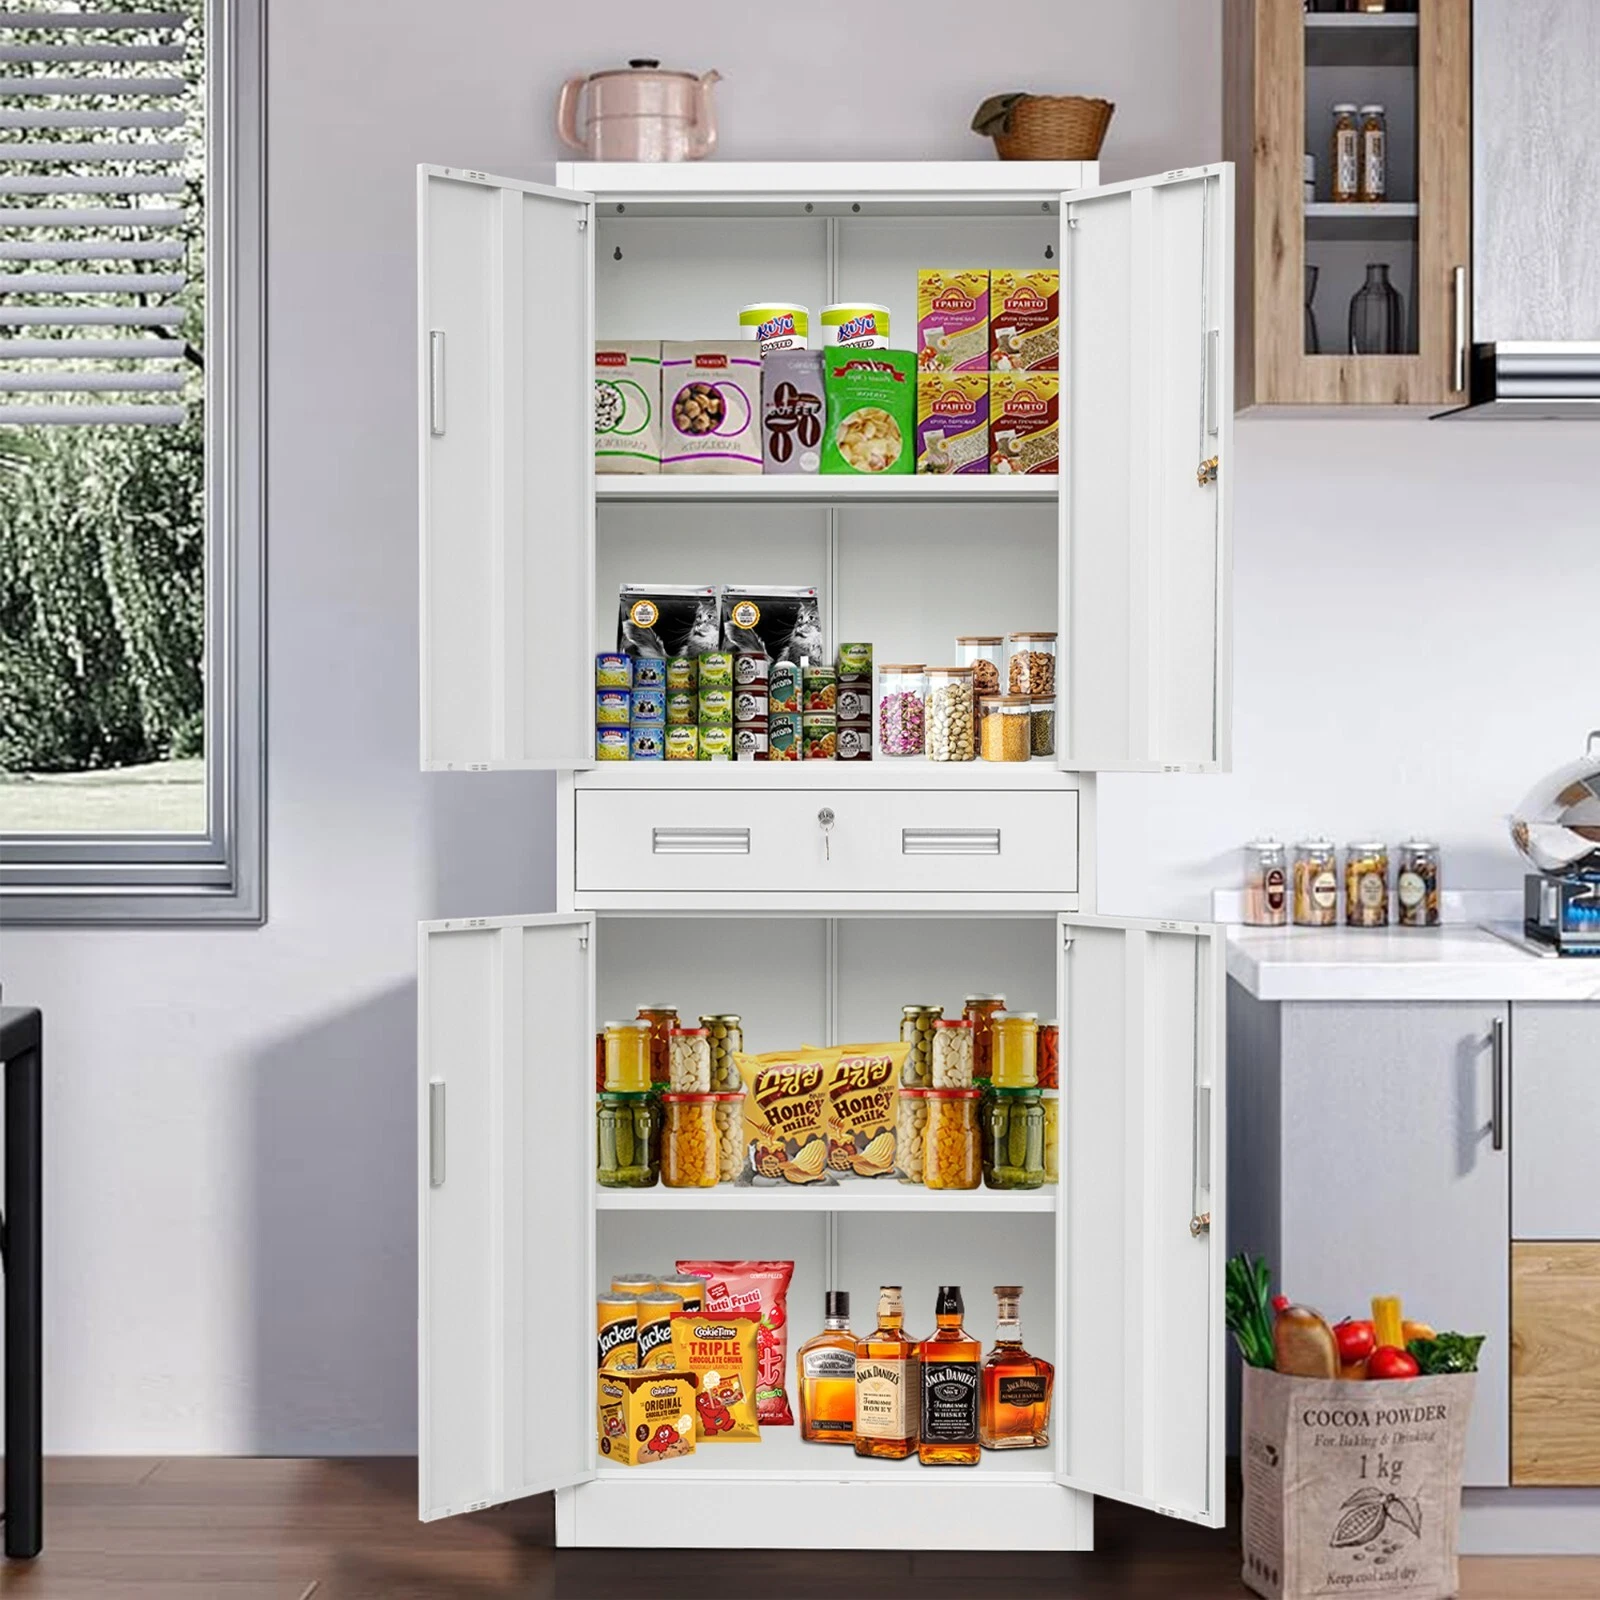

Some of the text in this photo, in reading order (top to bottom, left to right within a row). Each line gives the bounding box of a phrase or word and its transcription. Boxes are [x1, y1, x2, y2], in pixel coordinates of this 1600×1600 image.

[762, 339, 792, 350] OASTED
[764, 1099, 825, 1126] Honey
[833, 1092, 893, 1119] Honey
[782, 1116, 816, 1133] milk
[851, 1109, 885, 1125] milk
[731, 1290, 761, 1306] Frutti
[598, 1325, 637, 1357] Jacker
[637, 1325, 671, 1357] Jacke
[689, 1342, 740, 1355] TRIPLE
[857, 1366, 899, 1385] JACK DANIEL'S
[925, 1368, 976, 1387] JACK DANIEL'S
[645, 1397, 682, 1411] ORIGINAL
[1303, 1405, 1447, 1427] COCOA POWDER
[1314, 1434, 1335, 1447] For
[1360, 1453, 1404, 1486] 1 kg
[1327, 1572, 1353, 1588] Keep
